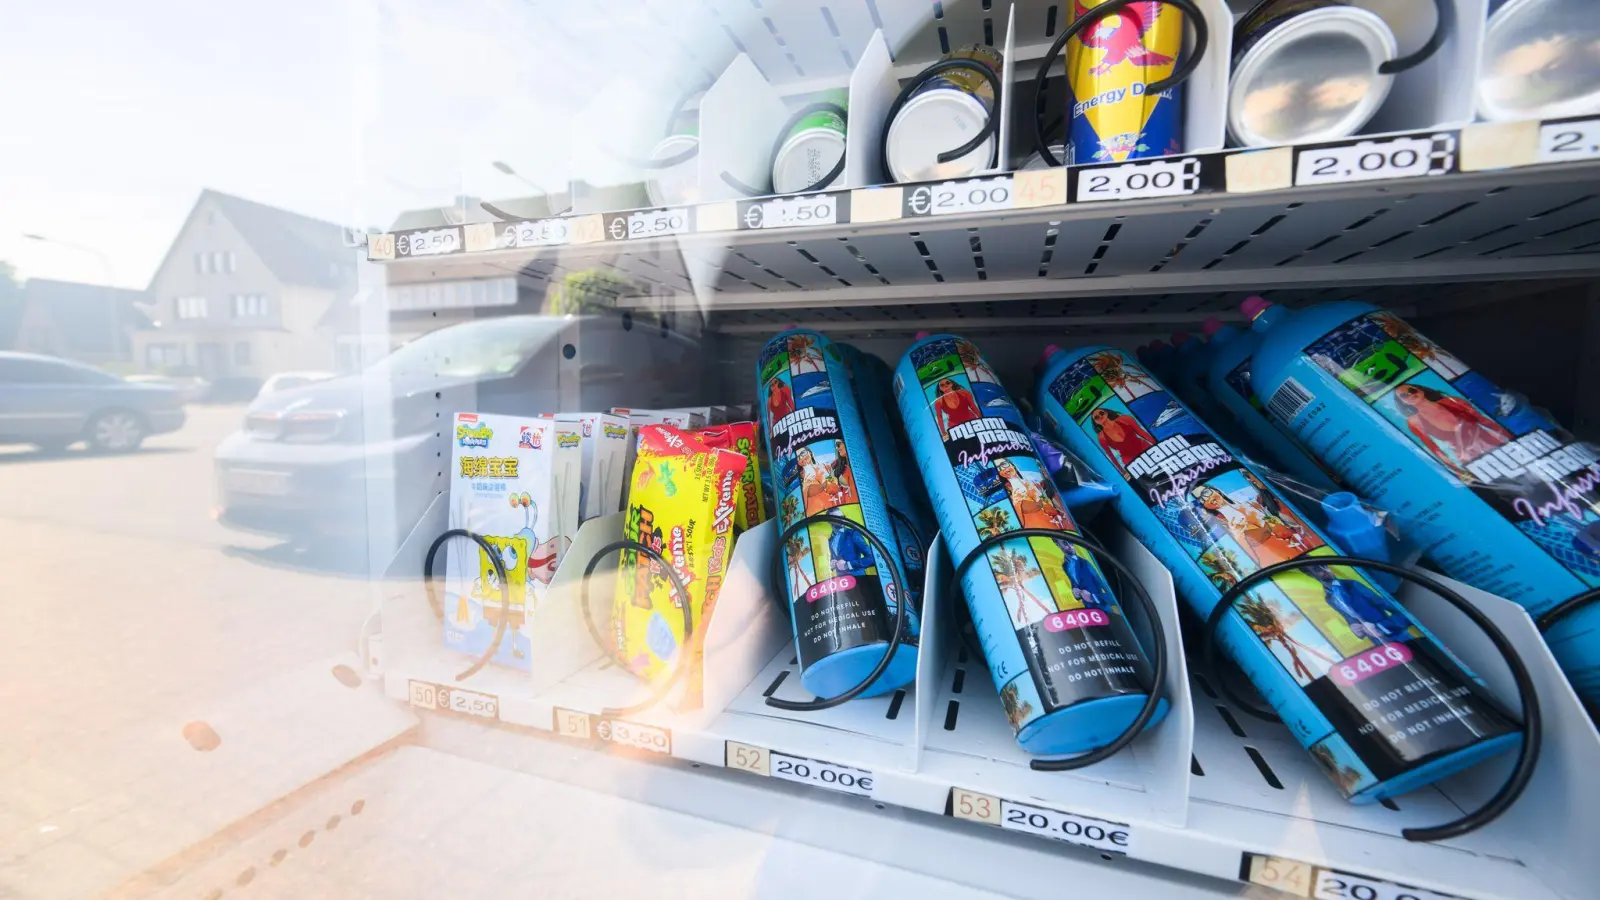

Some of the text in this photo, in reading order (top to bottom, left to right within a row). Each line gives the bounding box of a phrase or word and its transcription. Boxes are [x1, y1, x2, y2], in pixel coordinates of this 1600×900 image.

[1073, 87, 1127, 119] Energy
[1019, 175, 1057, 200] 45
[372, 237, 392, 256] 40
[459, 456, 519, 479] 海绵宝宝
[810, 577, 850, 599] 640G
[810, 601, 860, 621] DO NOT REFILL
[1051, 611, 1103, 629] 640G
[803, 609, 877, 638] NOT FOR MEDICAL USE
[812, 635, 822, 644] DO
[838, 621, 866, 634] INHALE
[1058, 639, 1122, 655] DO NOT REFILL
[1047, 664, 1065, 673] NOT
[1067, 657, 1087, 667] FOR
[1087, 653, 1125, 663] MEDICAL
[1067, 666, 1136, 683] DO NOT INHALE
[1339, 645, 1404, 682] 640G
[415, 686, 433, 706] 50
[1361, 698, 1380, 711] DO
[1380, 688, 1404, 706] NOT
[1357, 719, 1381, 736] NOT
[1381, 709, 1405, 726] FOR
[1388, 731, 1406, 744] DO
[1408, 720, 1432, 736] NOT
[735, 747, 761, 770] 52
[958, 795, 991, 819] 53
[1260, 859, 1303, 888] 54
